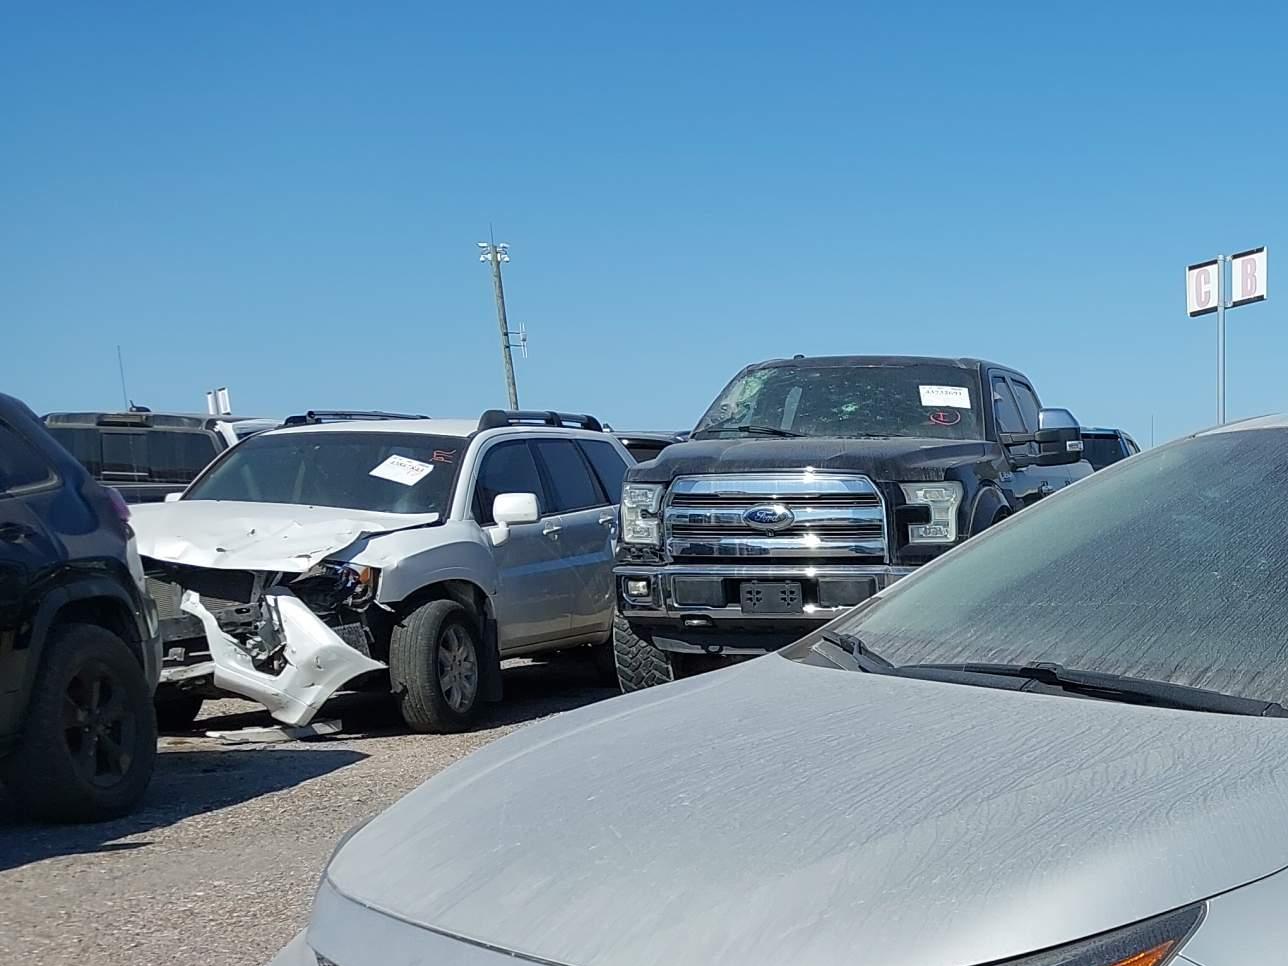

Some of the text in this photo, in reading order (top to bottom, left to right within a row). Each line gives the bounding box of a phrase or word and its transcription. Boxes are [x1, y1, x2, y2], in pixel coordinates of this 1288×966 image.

[1195, 268, 1211, 308] C
[1241, 257, 1257, 298] B
[754, 510, 779, 522] Ford
